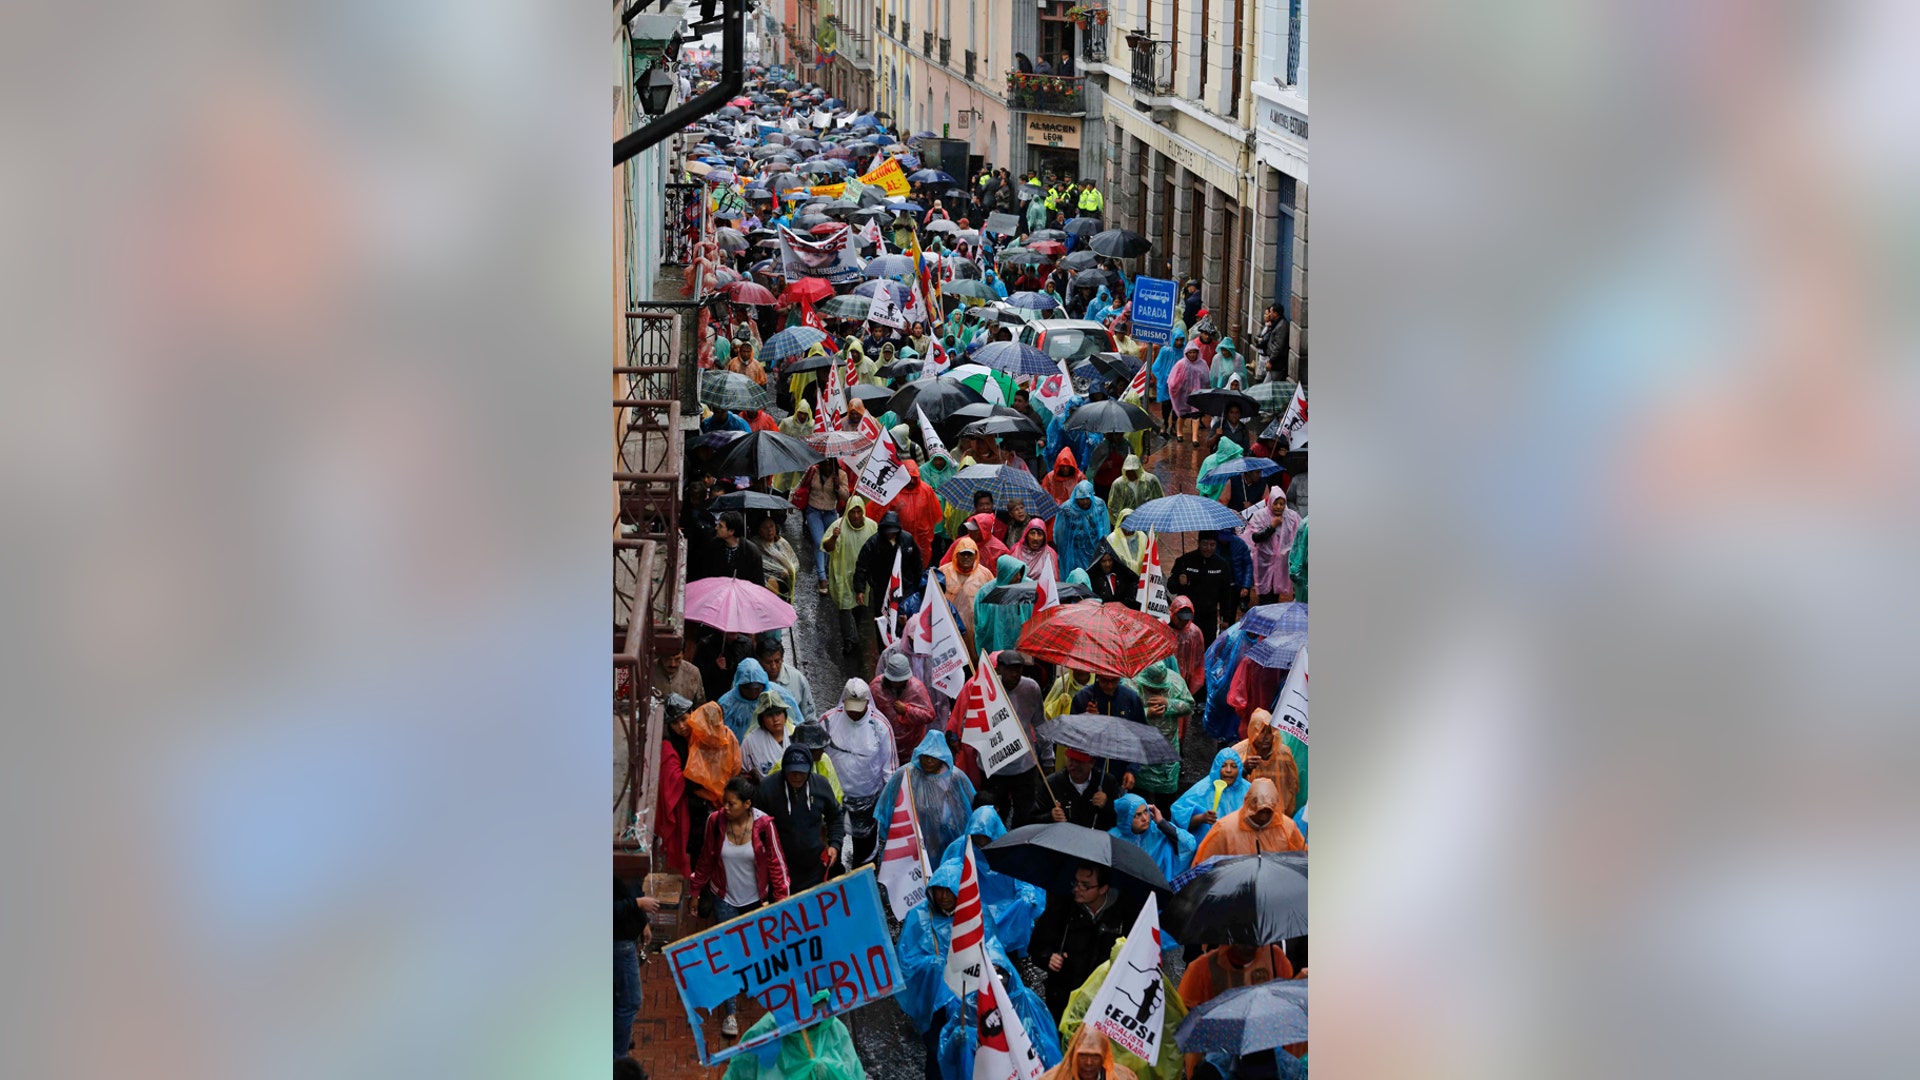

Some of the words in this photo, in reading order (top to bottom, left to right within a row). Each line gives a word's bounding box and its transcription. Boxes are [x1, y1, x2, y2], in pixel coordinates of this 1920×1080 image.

[1030, 122, 1075, 133] ALMACEN
[1138, 305, 1167, 319] PARADA
[1135, 328, 1167, 340] TURISMO
[861, 476, 888, 498] CEOSL
[671, 885, 851, 990] FETRALPI
[732, 935, 823, 993] JUNTO
